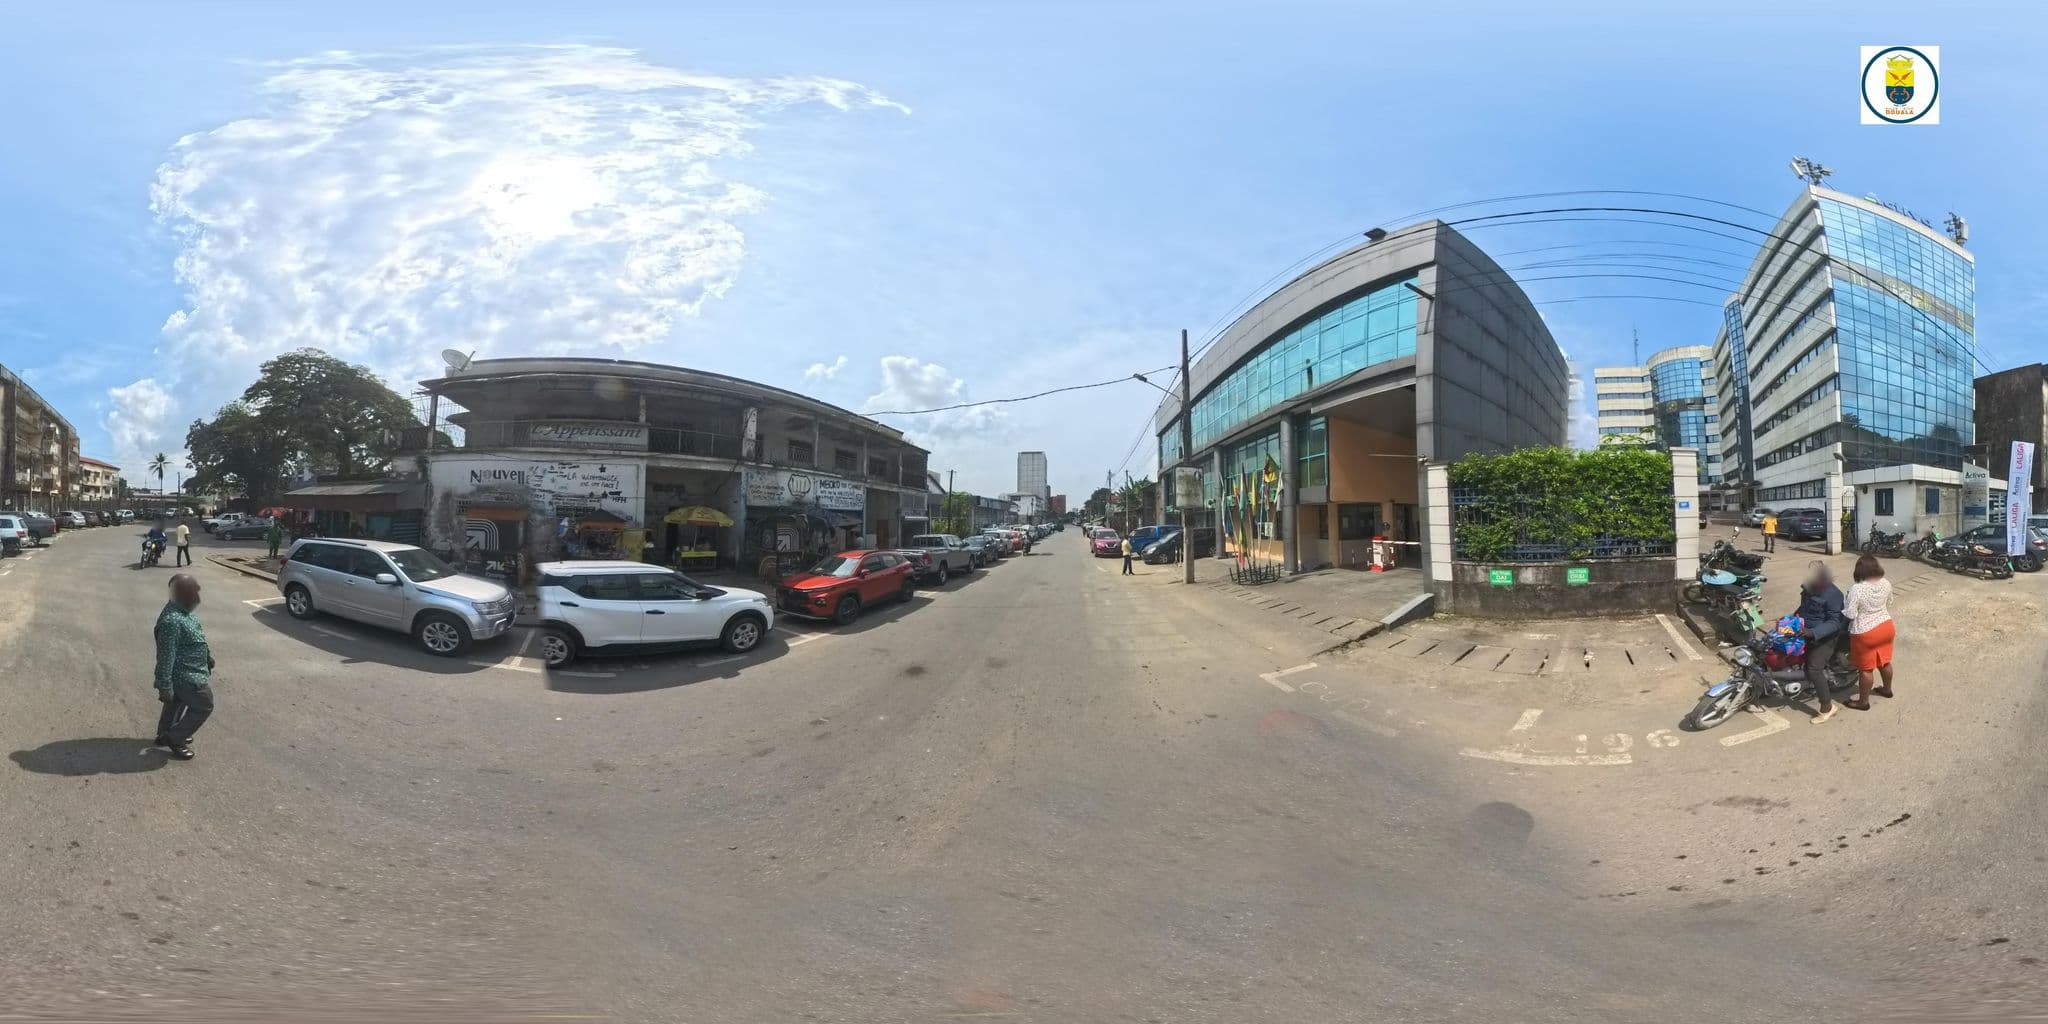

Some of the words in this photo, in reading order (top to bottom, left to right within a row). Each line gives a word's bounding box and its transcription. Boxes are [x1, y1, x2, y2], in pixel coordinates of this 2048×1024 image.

[2016, 443, 2025, 470] LALIGA
[1965, 471, 1986, 479] Activa
[1575, 729, 1681, 753] 196
